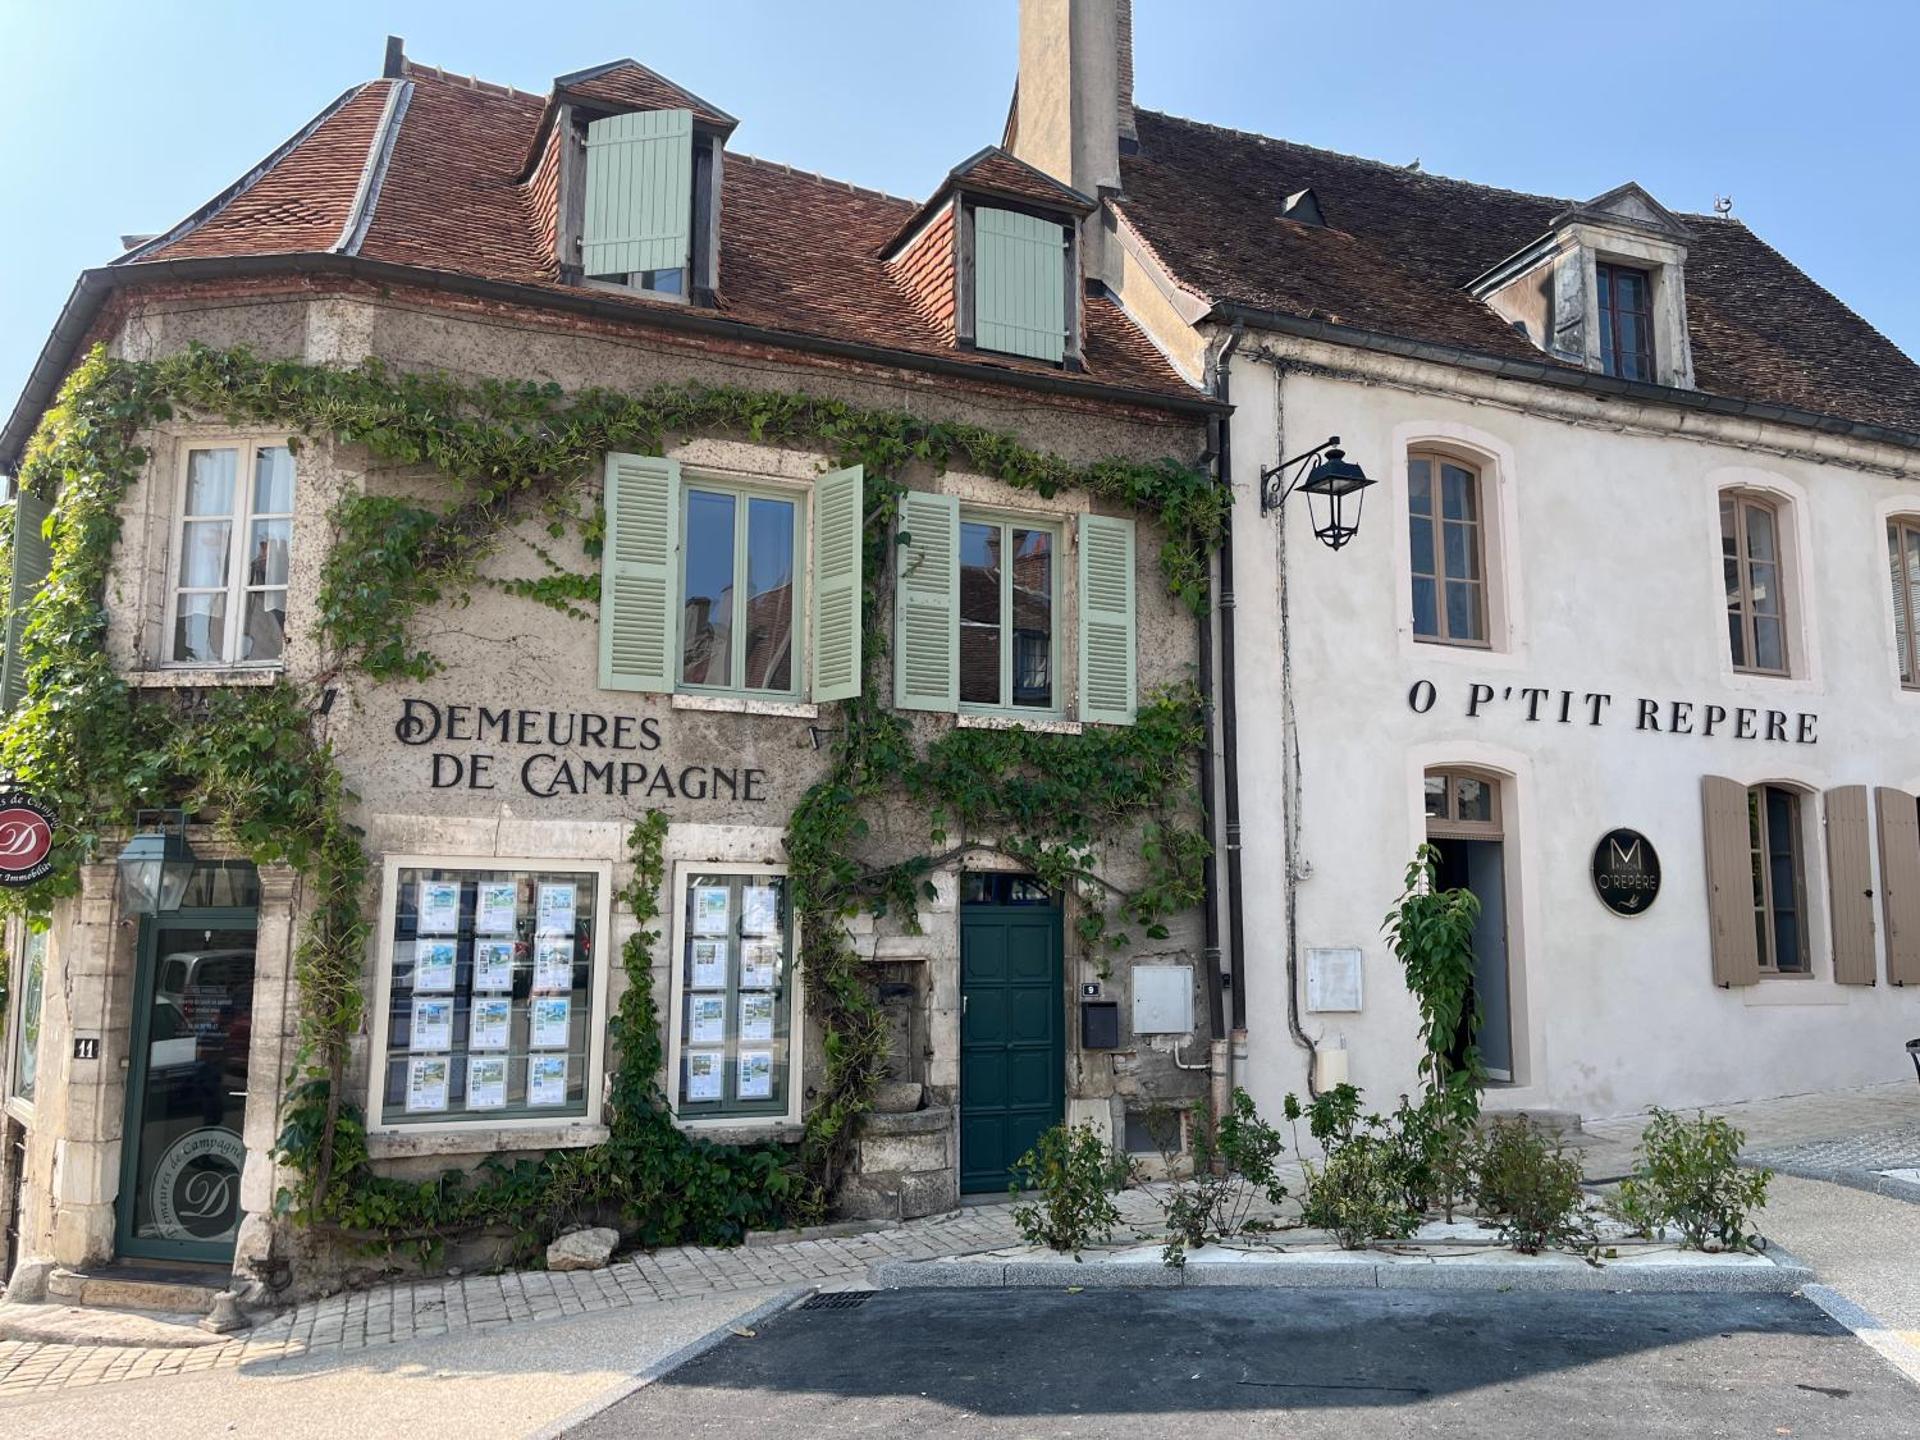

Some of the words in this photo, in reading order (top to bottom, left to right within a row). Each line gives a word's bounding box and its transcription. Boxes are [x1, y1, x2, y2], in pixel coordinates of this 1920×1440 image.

[395, 698, 662, 751] DEMEURES
[1408, 680, 1437, 714] O
[1465, 683, 1612, 726] P'TIT
[1635, 698, 1820, 744] REPERE
[430, 753, 496, 790] DE
[520, 753, 767, 801] CAMPAGNE
[1088, 986, 1095, 994] 9
[78, 1039, 93, 1058] 11
[169, 1151, 182, 1169] de
